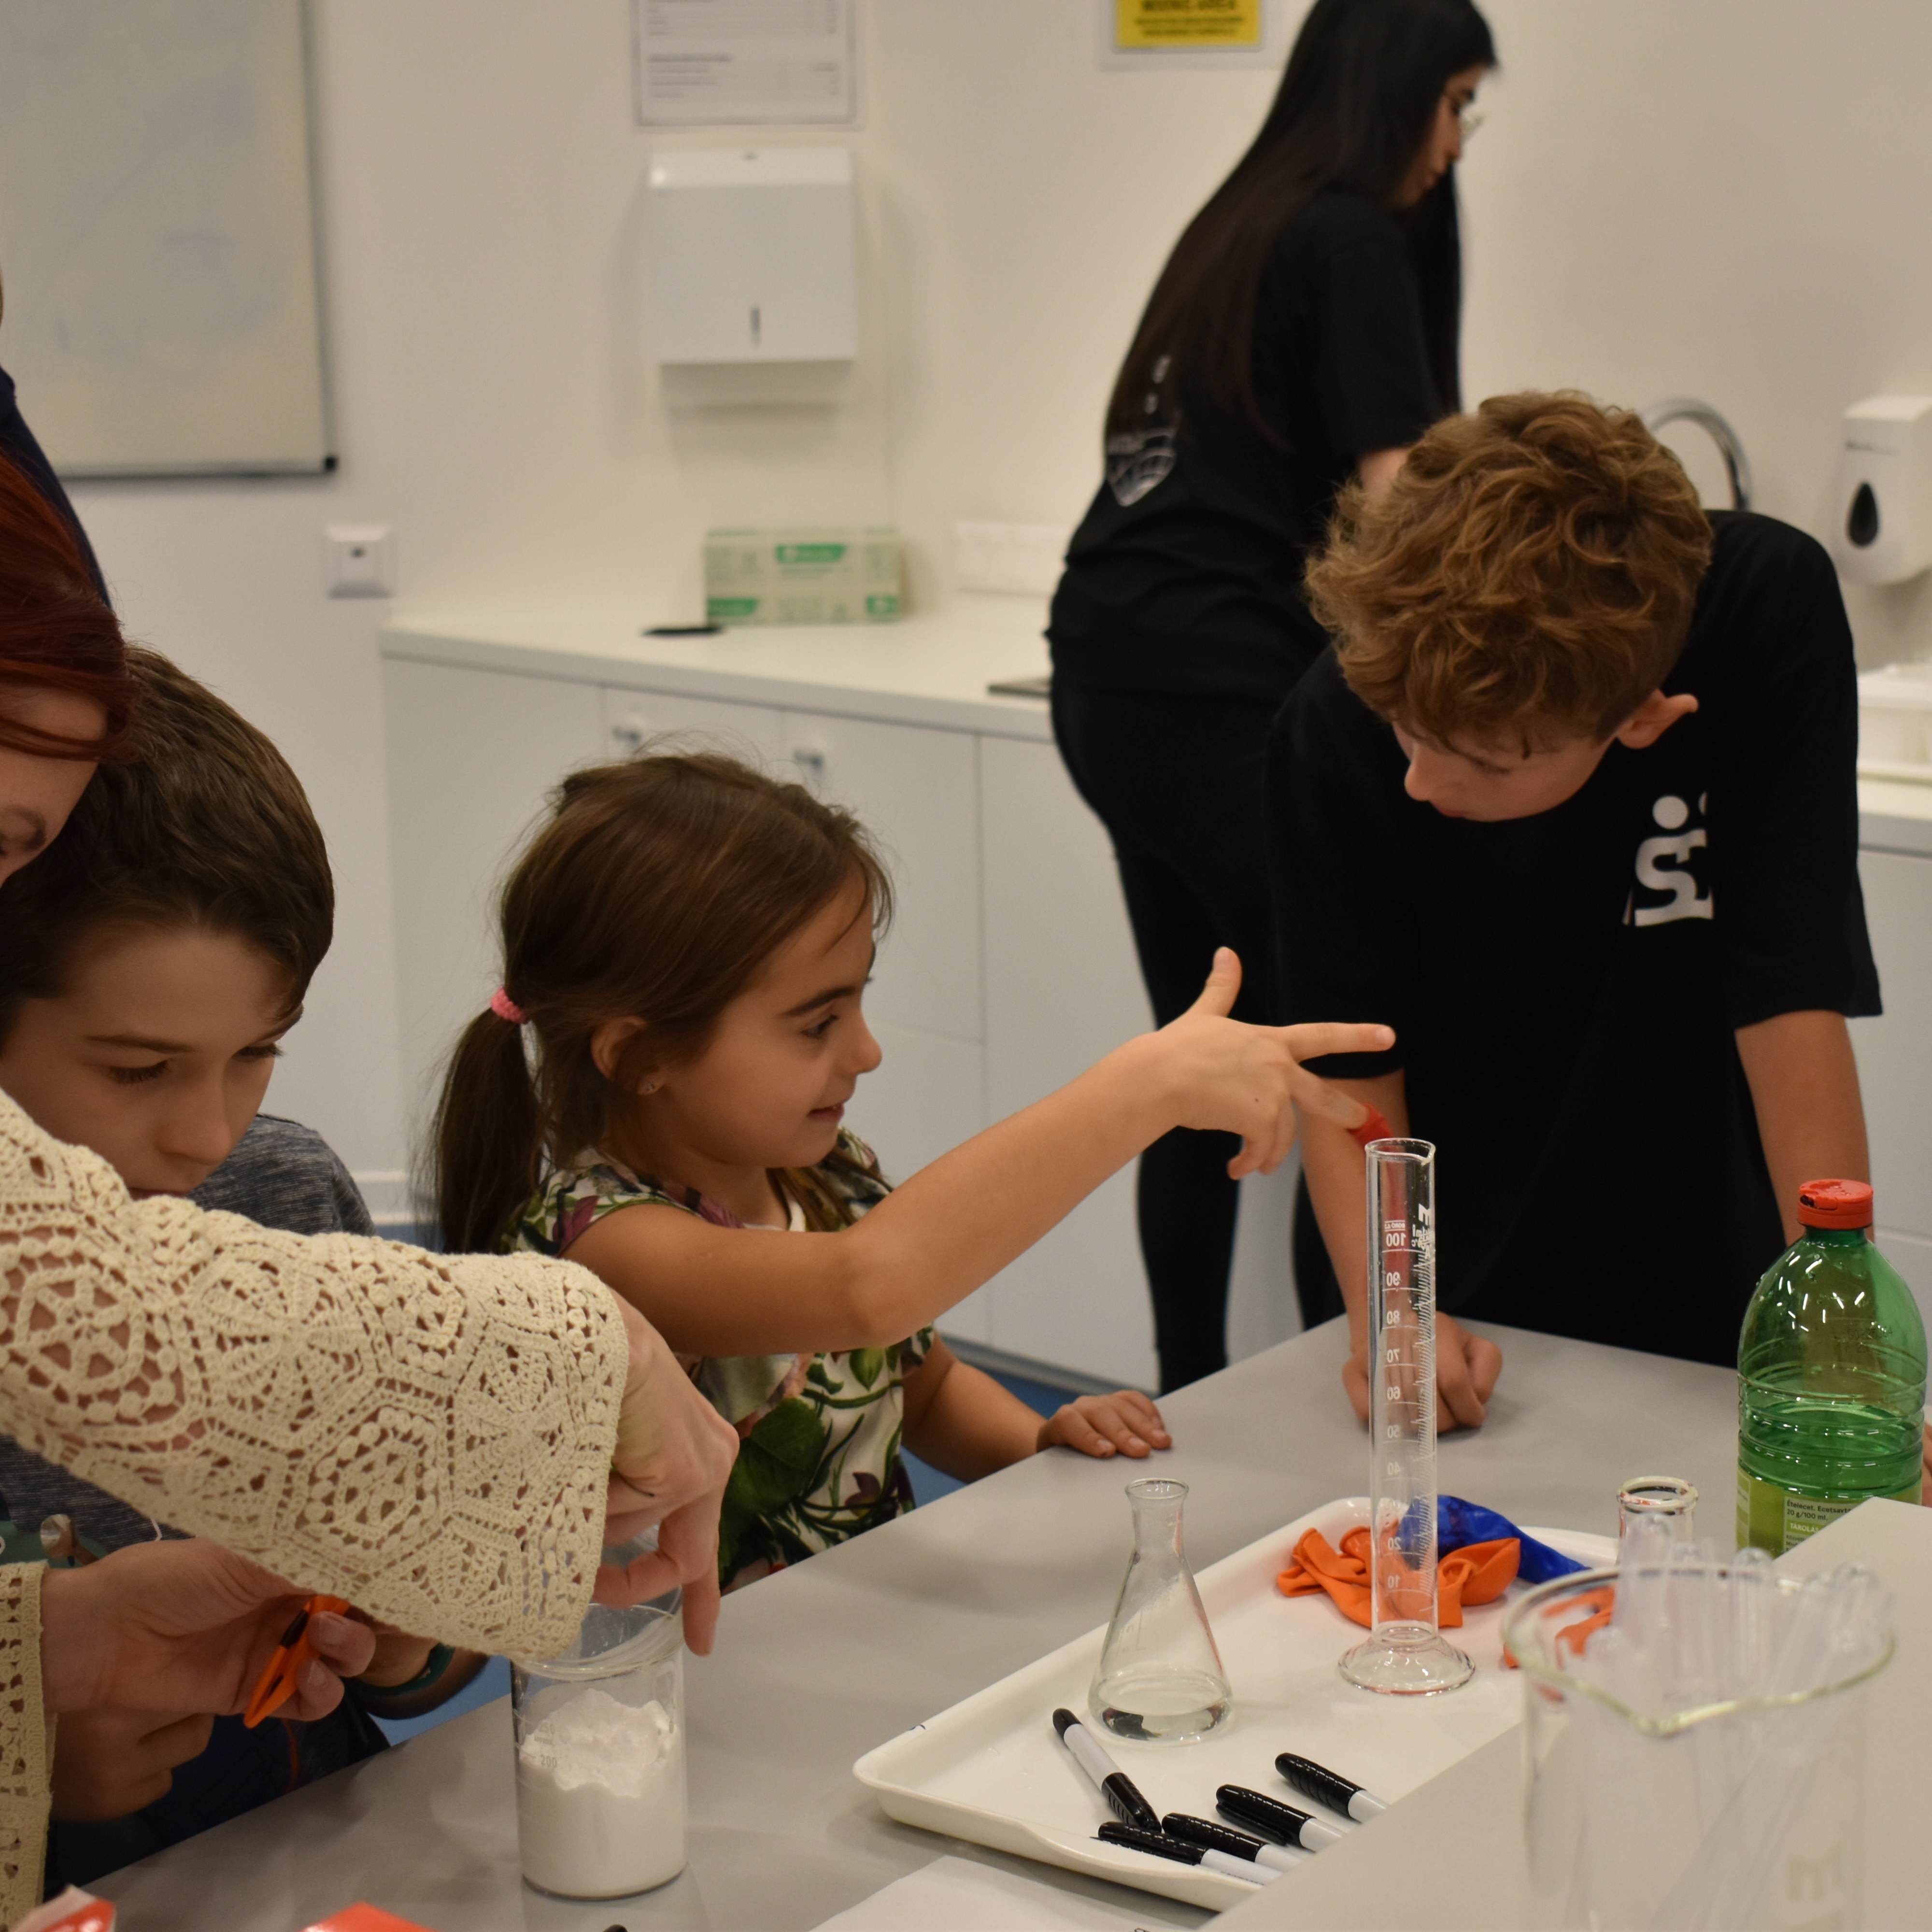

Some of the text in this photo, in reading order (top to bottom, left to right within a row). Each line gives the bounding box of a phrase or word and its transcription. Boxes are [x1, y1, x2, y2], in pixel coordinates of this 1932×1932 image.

[1787, 1500, 1815, 1511] Ételecet.
[1796, 1510, 1815, 1519] g/100
[540, 1754, 557, 1768] 200
